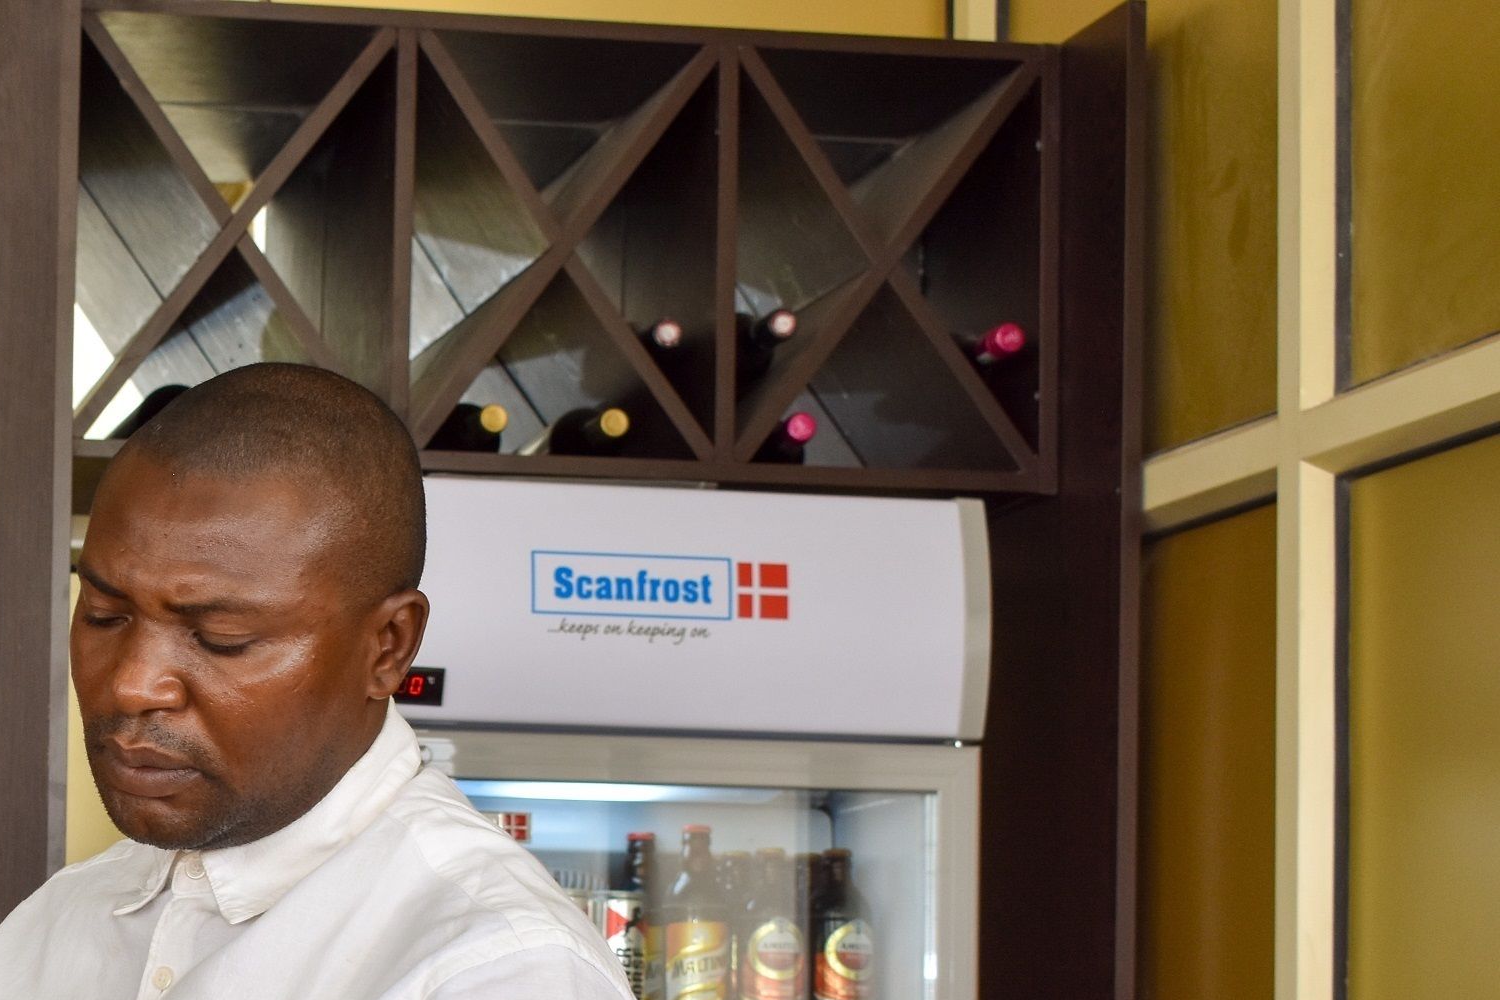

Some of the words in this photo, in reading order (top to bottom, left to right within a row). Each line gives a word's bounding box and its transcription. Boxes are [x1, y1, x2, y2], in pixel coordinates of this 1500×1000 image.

[553, 565, 713, 605] Scanfrost
[603, 623, 623, 636] on
[626, 620, 687, 646] keeping
[689, 626, 712, 639] on
